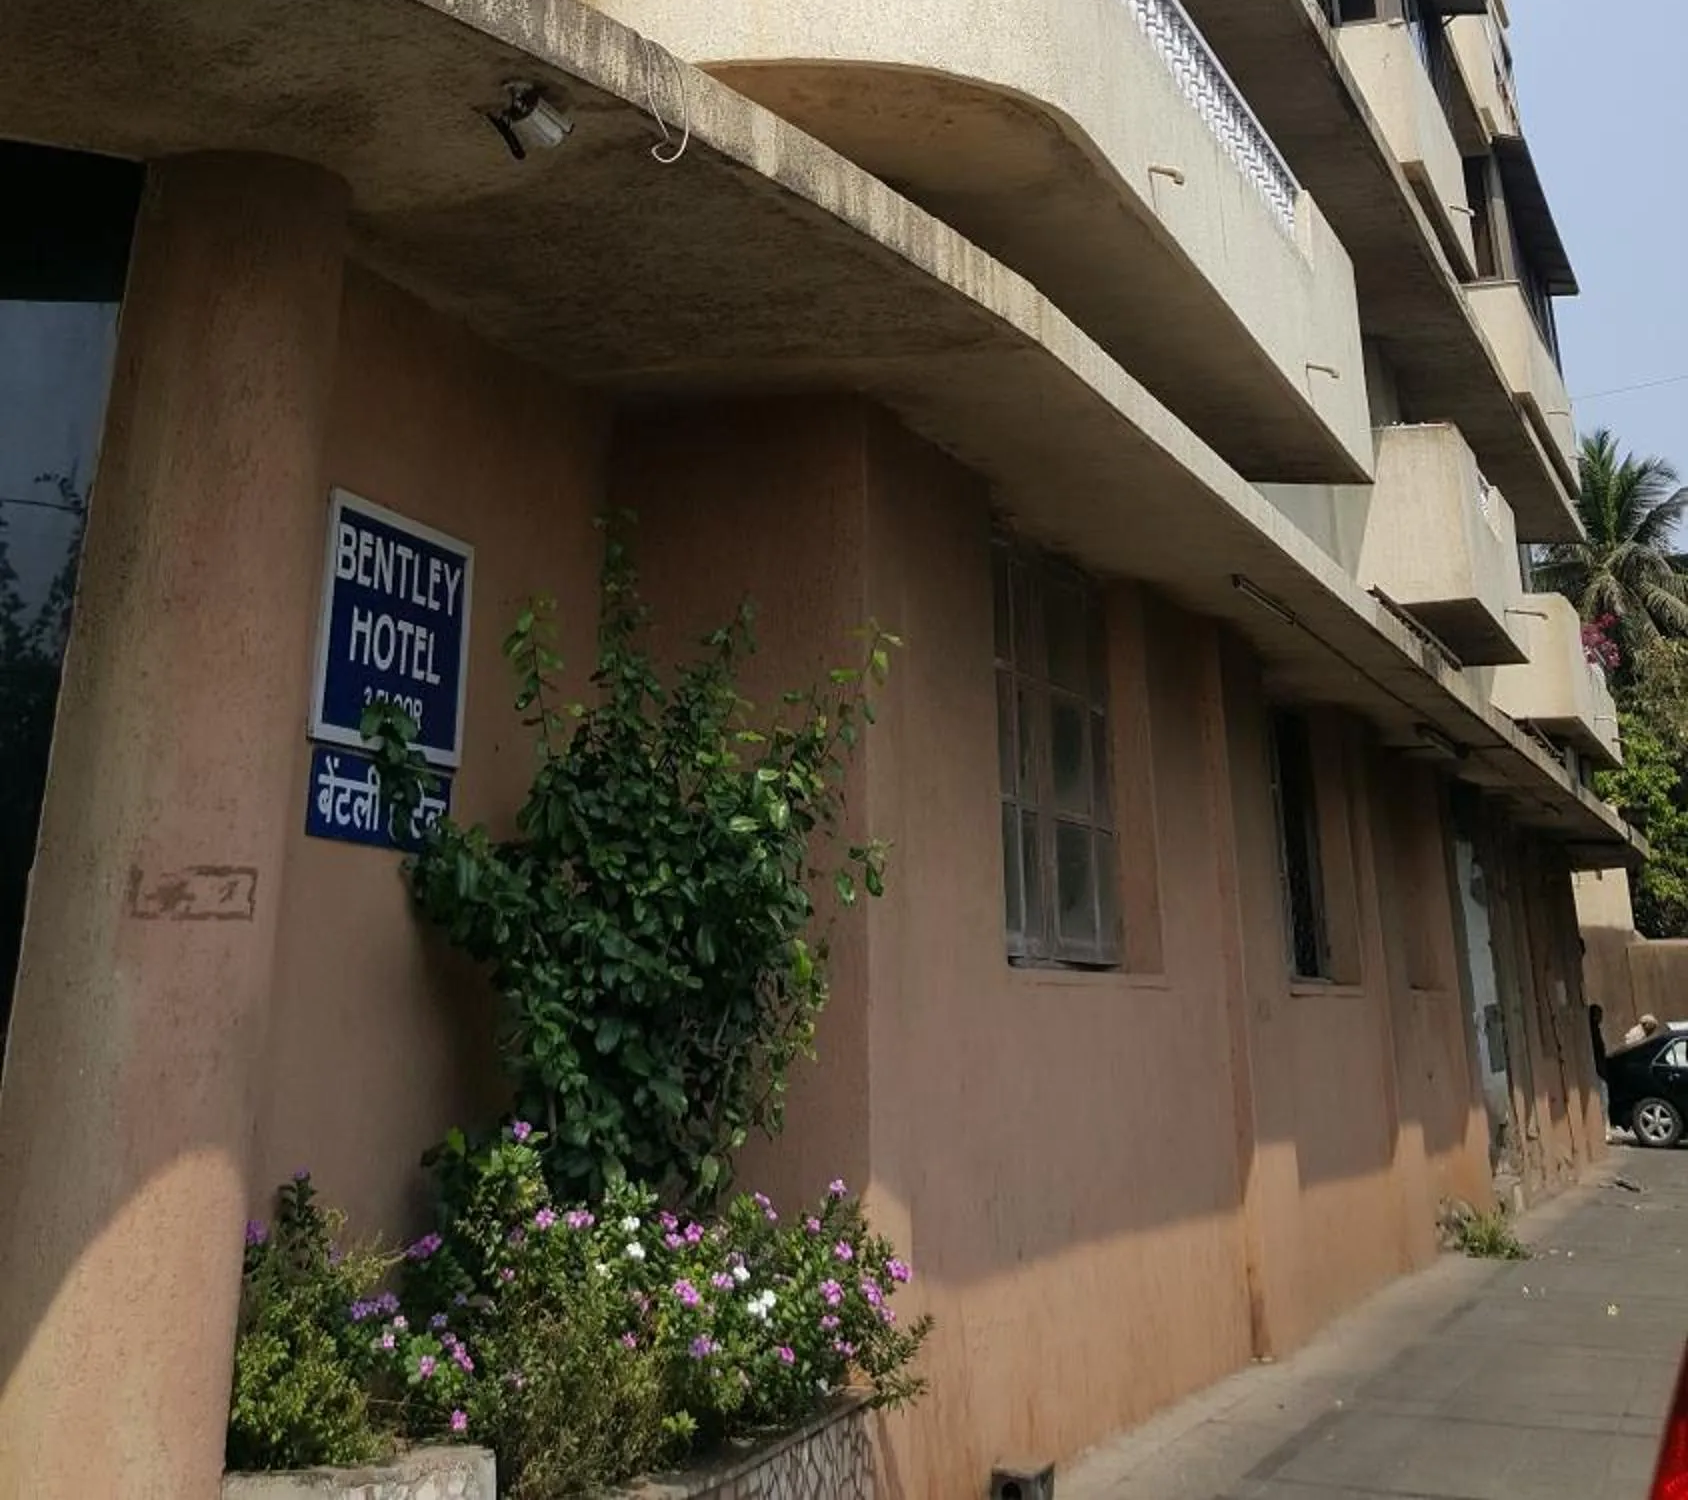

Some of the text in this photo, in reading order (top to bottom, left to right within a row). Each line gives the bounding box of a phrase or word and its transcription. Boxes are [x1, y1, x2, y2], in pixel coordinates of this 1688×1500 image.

[335, 522, 462, 616] BENTLEY
[349, 605, 441, 685] HOTEL
[318, 755, 381, 831] बेंटली
